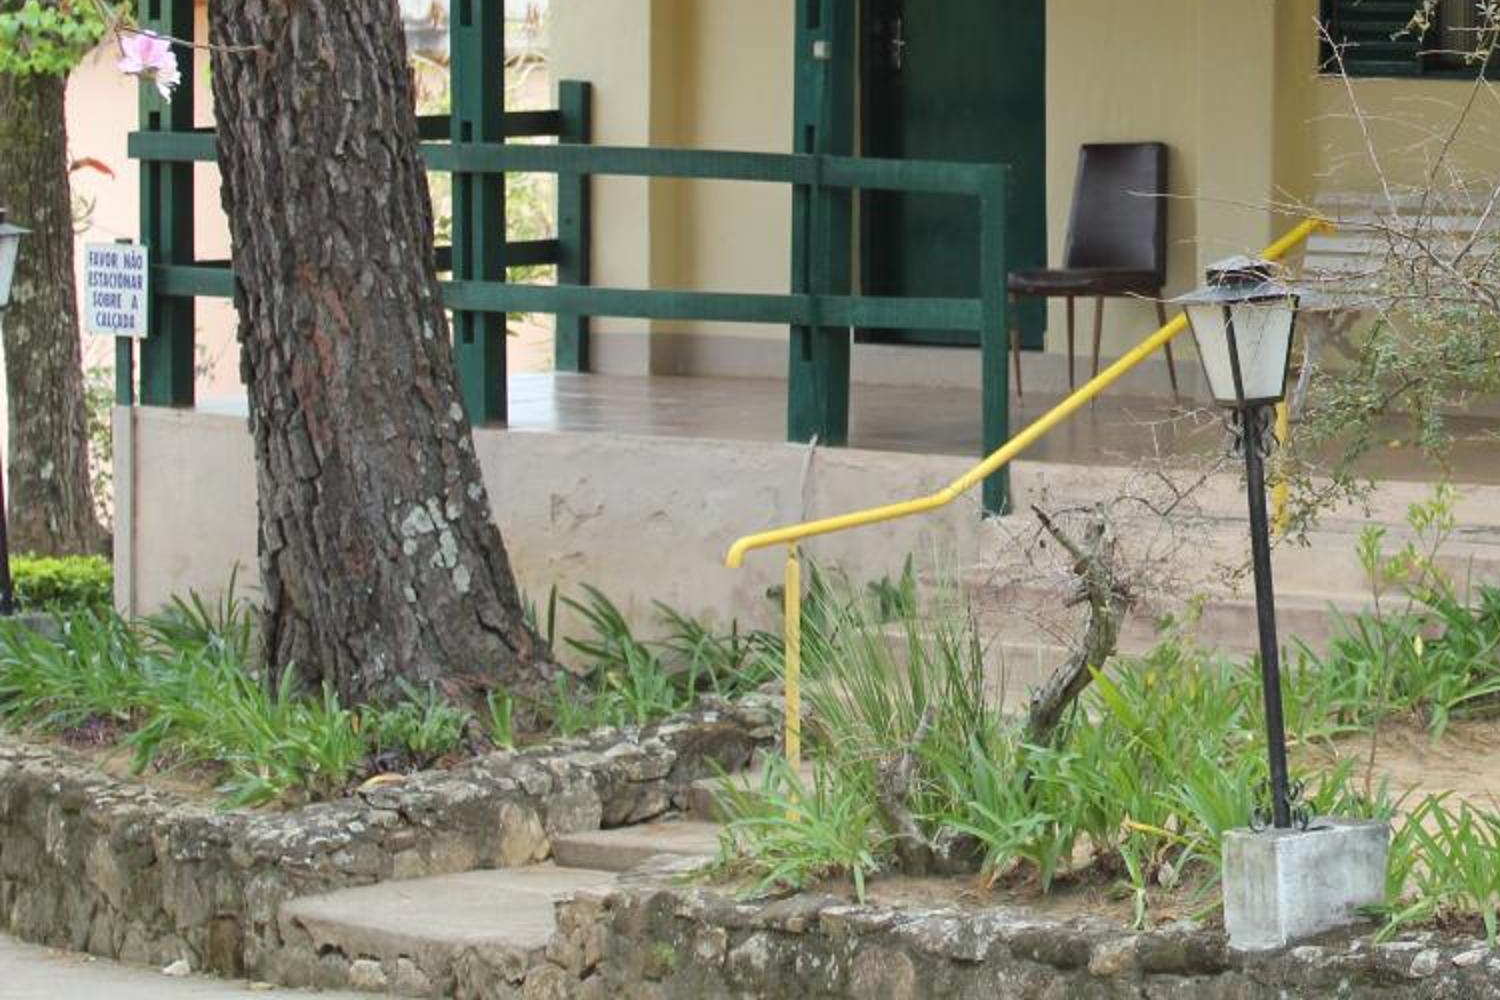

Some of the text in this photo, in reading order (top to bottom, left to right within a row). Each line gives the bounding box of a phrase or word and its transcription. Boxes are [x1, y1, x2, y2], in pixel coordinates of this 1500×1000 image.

[89, 250, 143, 269] FAVOR NÃO
[88, 271, 143, 290] ESTACIONAR
[93, 291, 139, 310] SOBRE A
